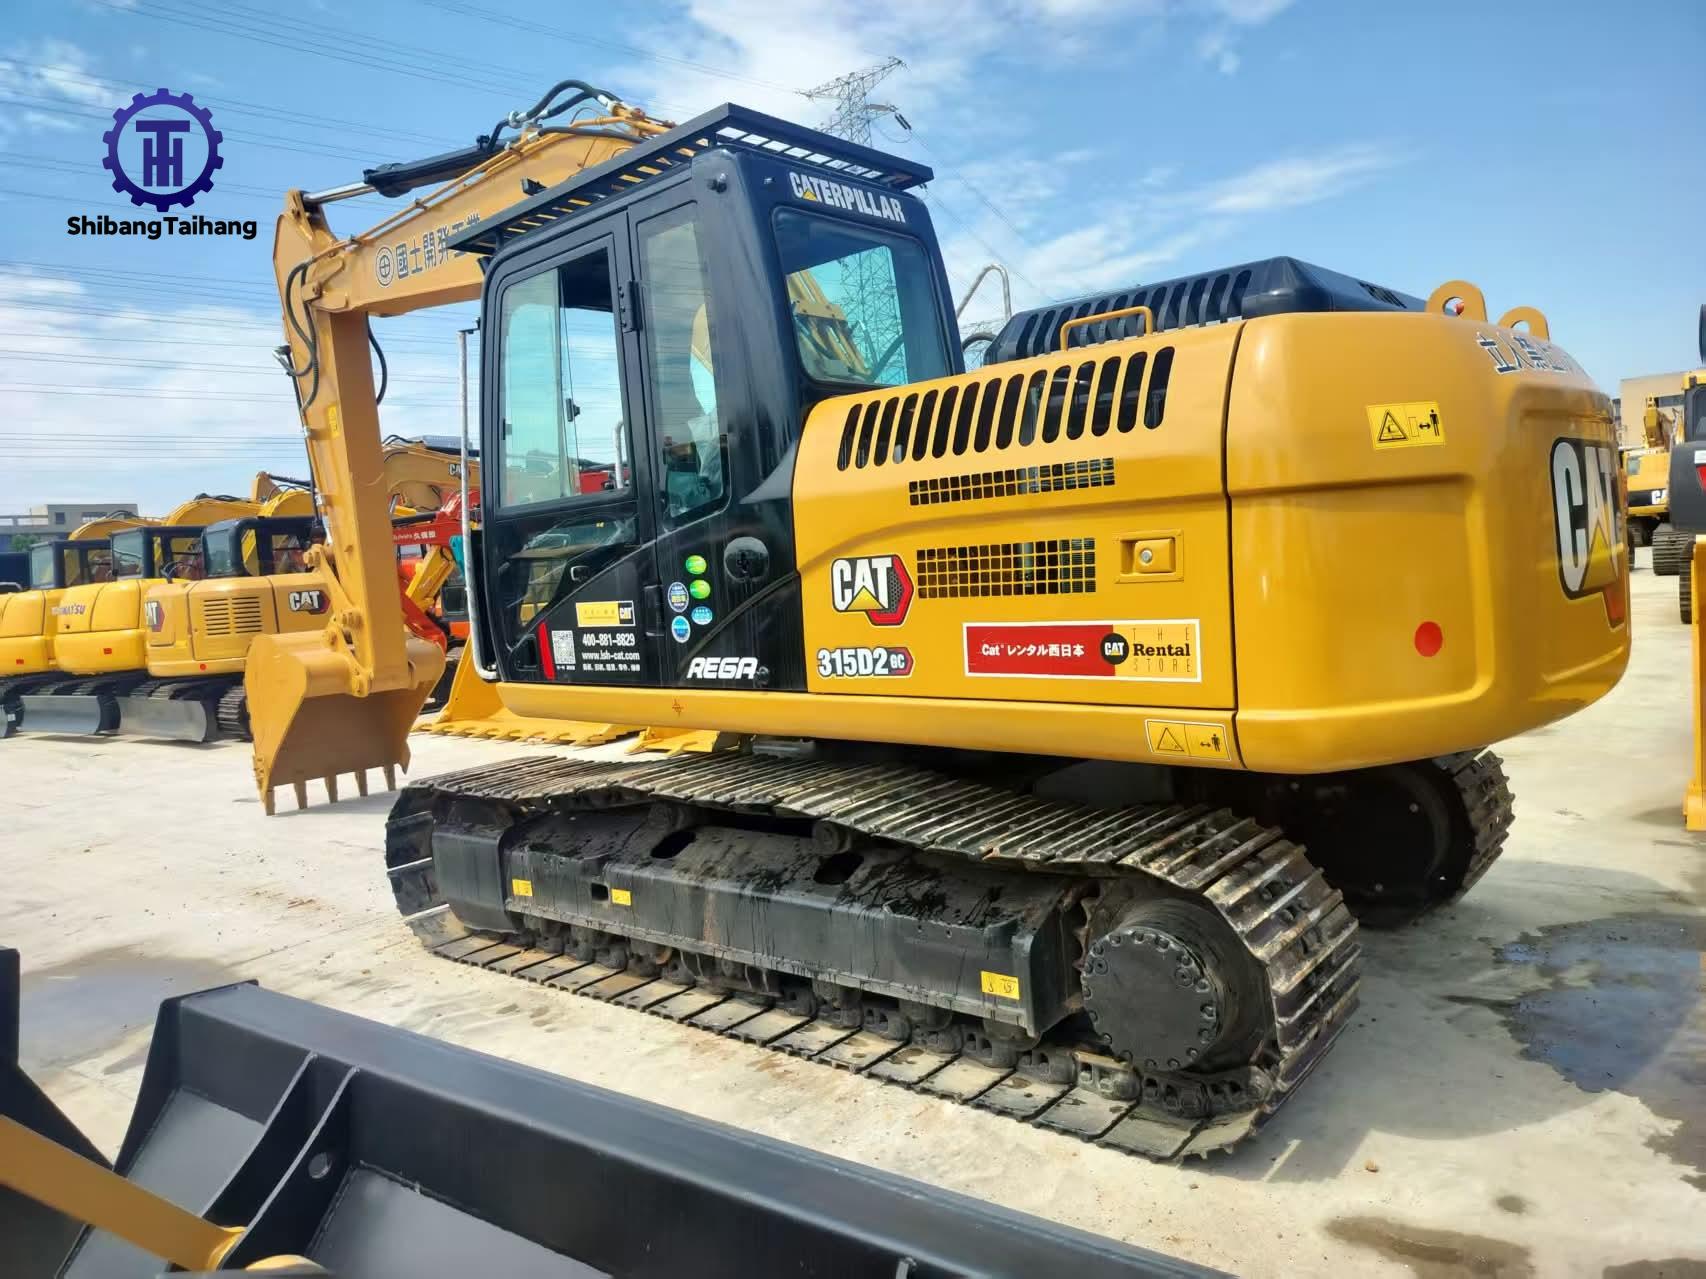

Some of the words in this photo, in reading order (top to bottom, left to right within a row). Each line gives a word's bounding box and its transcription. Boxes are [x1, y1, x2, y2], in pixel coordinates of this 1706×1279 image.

[789, 171, 906, 223] CATERPILLAR
[1552, 441, 1620, 592] CAT
[832, 557, 892, 610] CAT
[289, 590, 321, 612] CAT
[582, 633, 636, 647] 400-881-8829
[1104, 641, 1125, 656] CAT
[1007, 643, 1085, 657] レンタル西日本
[1133, 643, 1191, 657] Rental
[817, 647, 889, 676] 315D2
[1133, 658, 1191, 673] STORE
